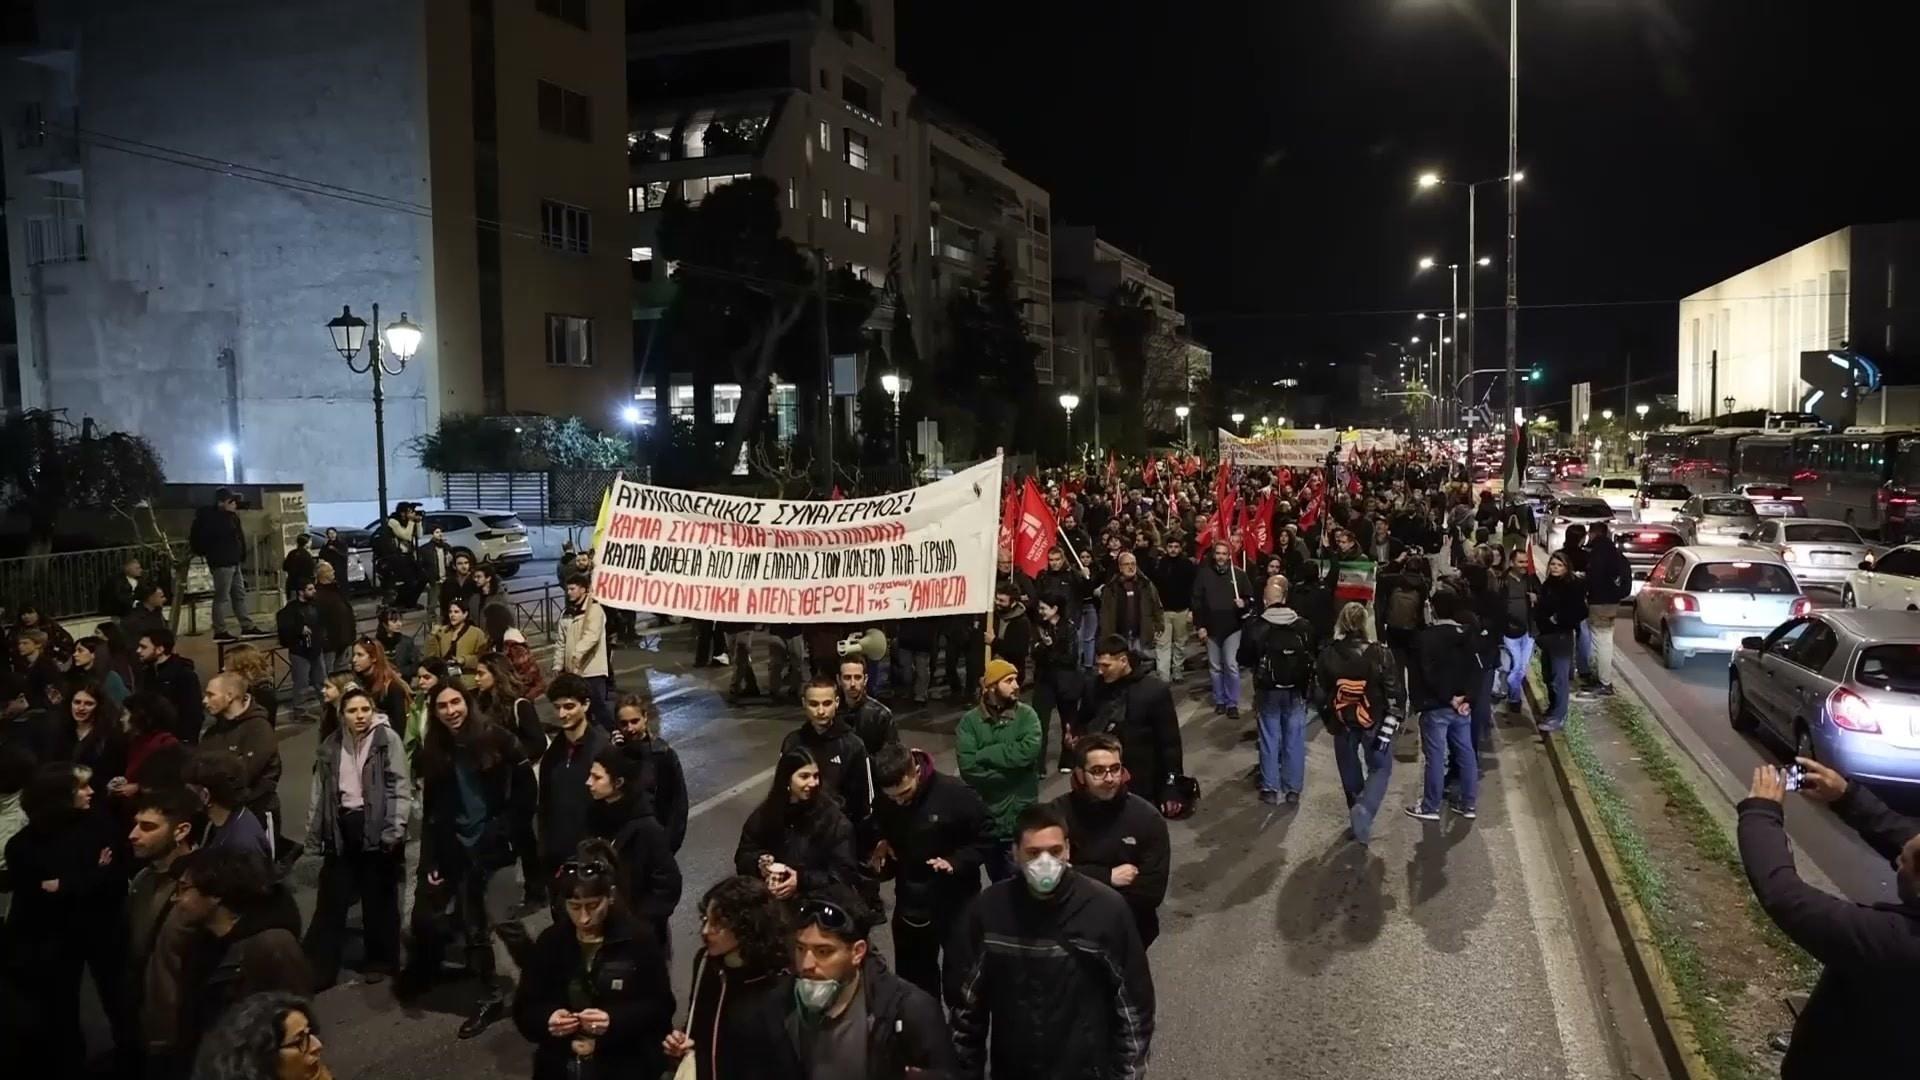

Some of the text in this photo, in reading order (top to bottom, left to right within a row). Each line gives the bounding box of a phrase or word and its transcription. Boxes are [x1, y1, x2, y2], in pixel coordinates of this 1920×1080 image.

[616, 484, 916, 526] ΑΝΤΙΠΟΛΕΜΙΚΟΣ ΣΥΝΑΓΕΡΜΟΣ!
[608, 512, 662, 541] ΚΑΜΙΑ
[602, 540, 645, 571] ΚΑΜΙΑ
[651, 543, 701, 577] ΒΟΗΘΕΙΑ
[706, 549, 734, 579] ΑΠΟ
[736, 551, 761, 580] ΤΗΝ
[763, 551, 809, 581] ΕΛΛΑΔΑ
[811, 551, 841, 581] ΣΤΟΝ
[842, 548, 886, 579] ΠΟΛΕΜΟ
[595, 571, 740, 614] ΚΟΜΜΟΥΝΙΣΤΙΚΗ
